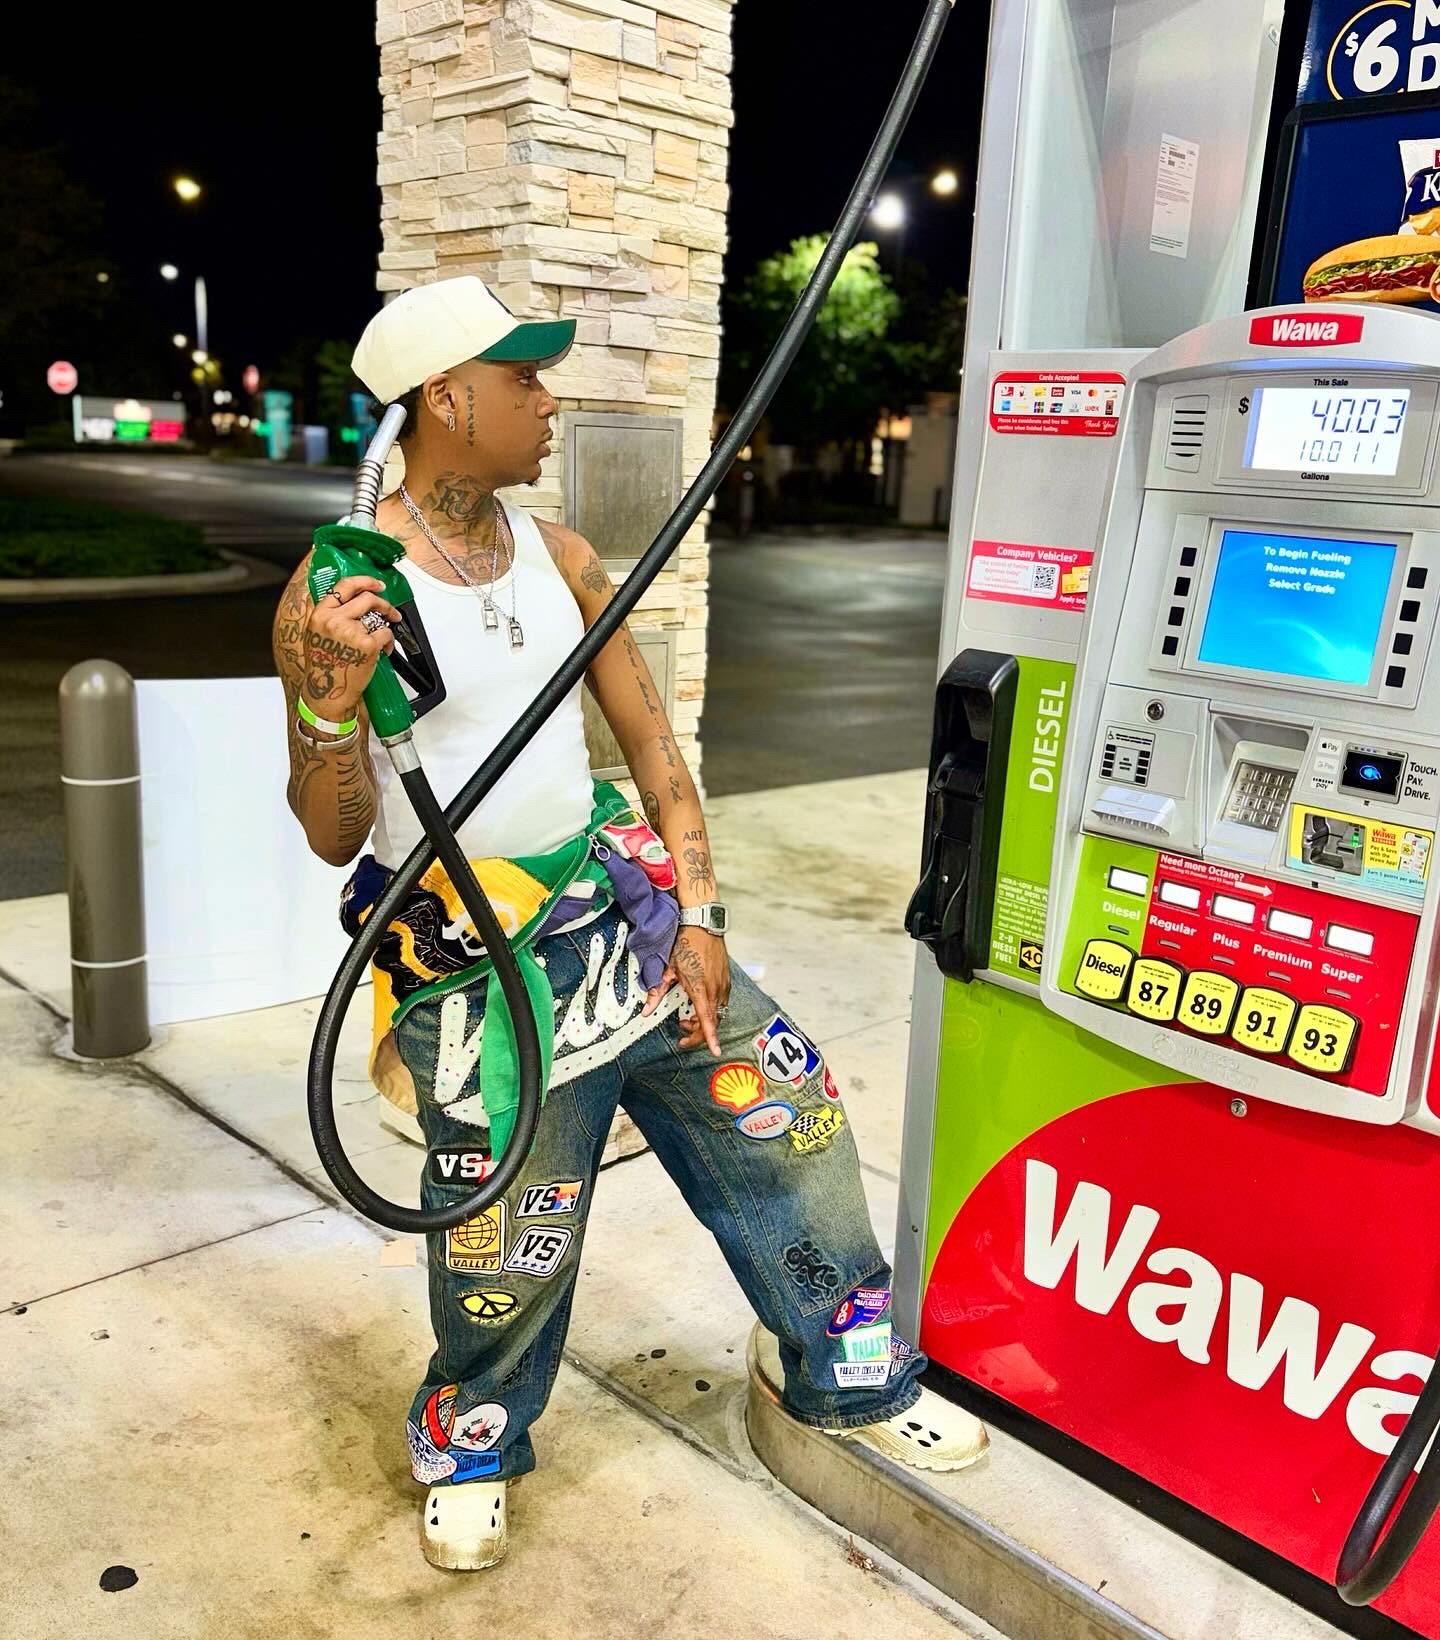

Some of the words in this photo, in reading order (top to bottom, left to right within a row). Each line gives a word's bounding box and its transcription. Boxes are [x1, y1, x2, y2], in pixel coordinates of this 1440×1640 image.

[1272, 319, 1339, 341] Wawa
[1055, 374, 1079, 382] Accepted
[1238, 397, 1249, 415] $
[1301, 472, 1330, 481] Gallons
[997, 546, 1036, 561] Company
[1037, 550, 1078, 563] Vehicles?
[1264, 546, 1276, 556] To
[1278, 547, 1308, 560] Begin
[1311, 551, 1352, 565] Fueling
[1265, 562, 1307, 577] Remove
[1310, 566, 1345, 580] Nozzle
[1268, 578, 1301, 591] Select
[1303, 582, 1336, 595] Grade
[1059, 595, 1075, 604] Apply
[1029, 680, 1067, 793] DIESEL
[1409, 762, 1438, 776] TOUCH.
[1406, 774, 1423, 786] PAY.
[1404, 787, 1431, 800] DRIVE.
[683, 830, 703, 842] ART
[1373, 829, 1396, 839] Wawa
[1160, 854, 1183, 868] Need
[1184, 862, 1206, 873] more
[1208, 866, 1245, 881] Octane?
[1103, 901, 1140, 920] Diesel
[1150, 915, 1197, 936] Regular
[993, 940, 1017, 955] DIESEL
[1212, 932, 1240, 949] Plus
[995, 951, 1013, 964] FUEL
[1023, 950, 1043, 965] 40
[1086, 953, 1126, 978] Diesel
[1253, 944, 1313, 970] Premium
[1321, 963, 1363, 983] Super
[1139, 981, 1169, 1006] 87
[1190, 993, 1222, 1019] 89
[1246, 1010, 1276, 1038] 91
[1303, 1028, 1338, 1056] 93
[767, 1037, 803, 1077] 14
[745, 1112, 785, 1133] VALLEY
[798, 1114, 836, 1147] VALLEY
[437, 1153, 484, 1178] VS
[523, 1186, 560, 1214] VS
[520, 1234, 561, 1261] VS
[453, 1259, 497, 1269] VALLEY
[1024, 1158, 1440, 1473] Wawa
